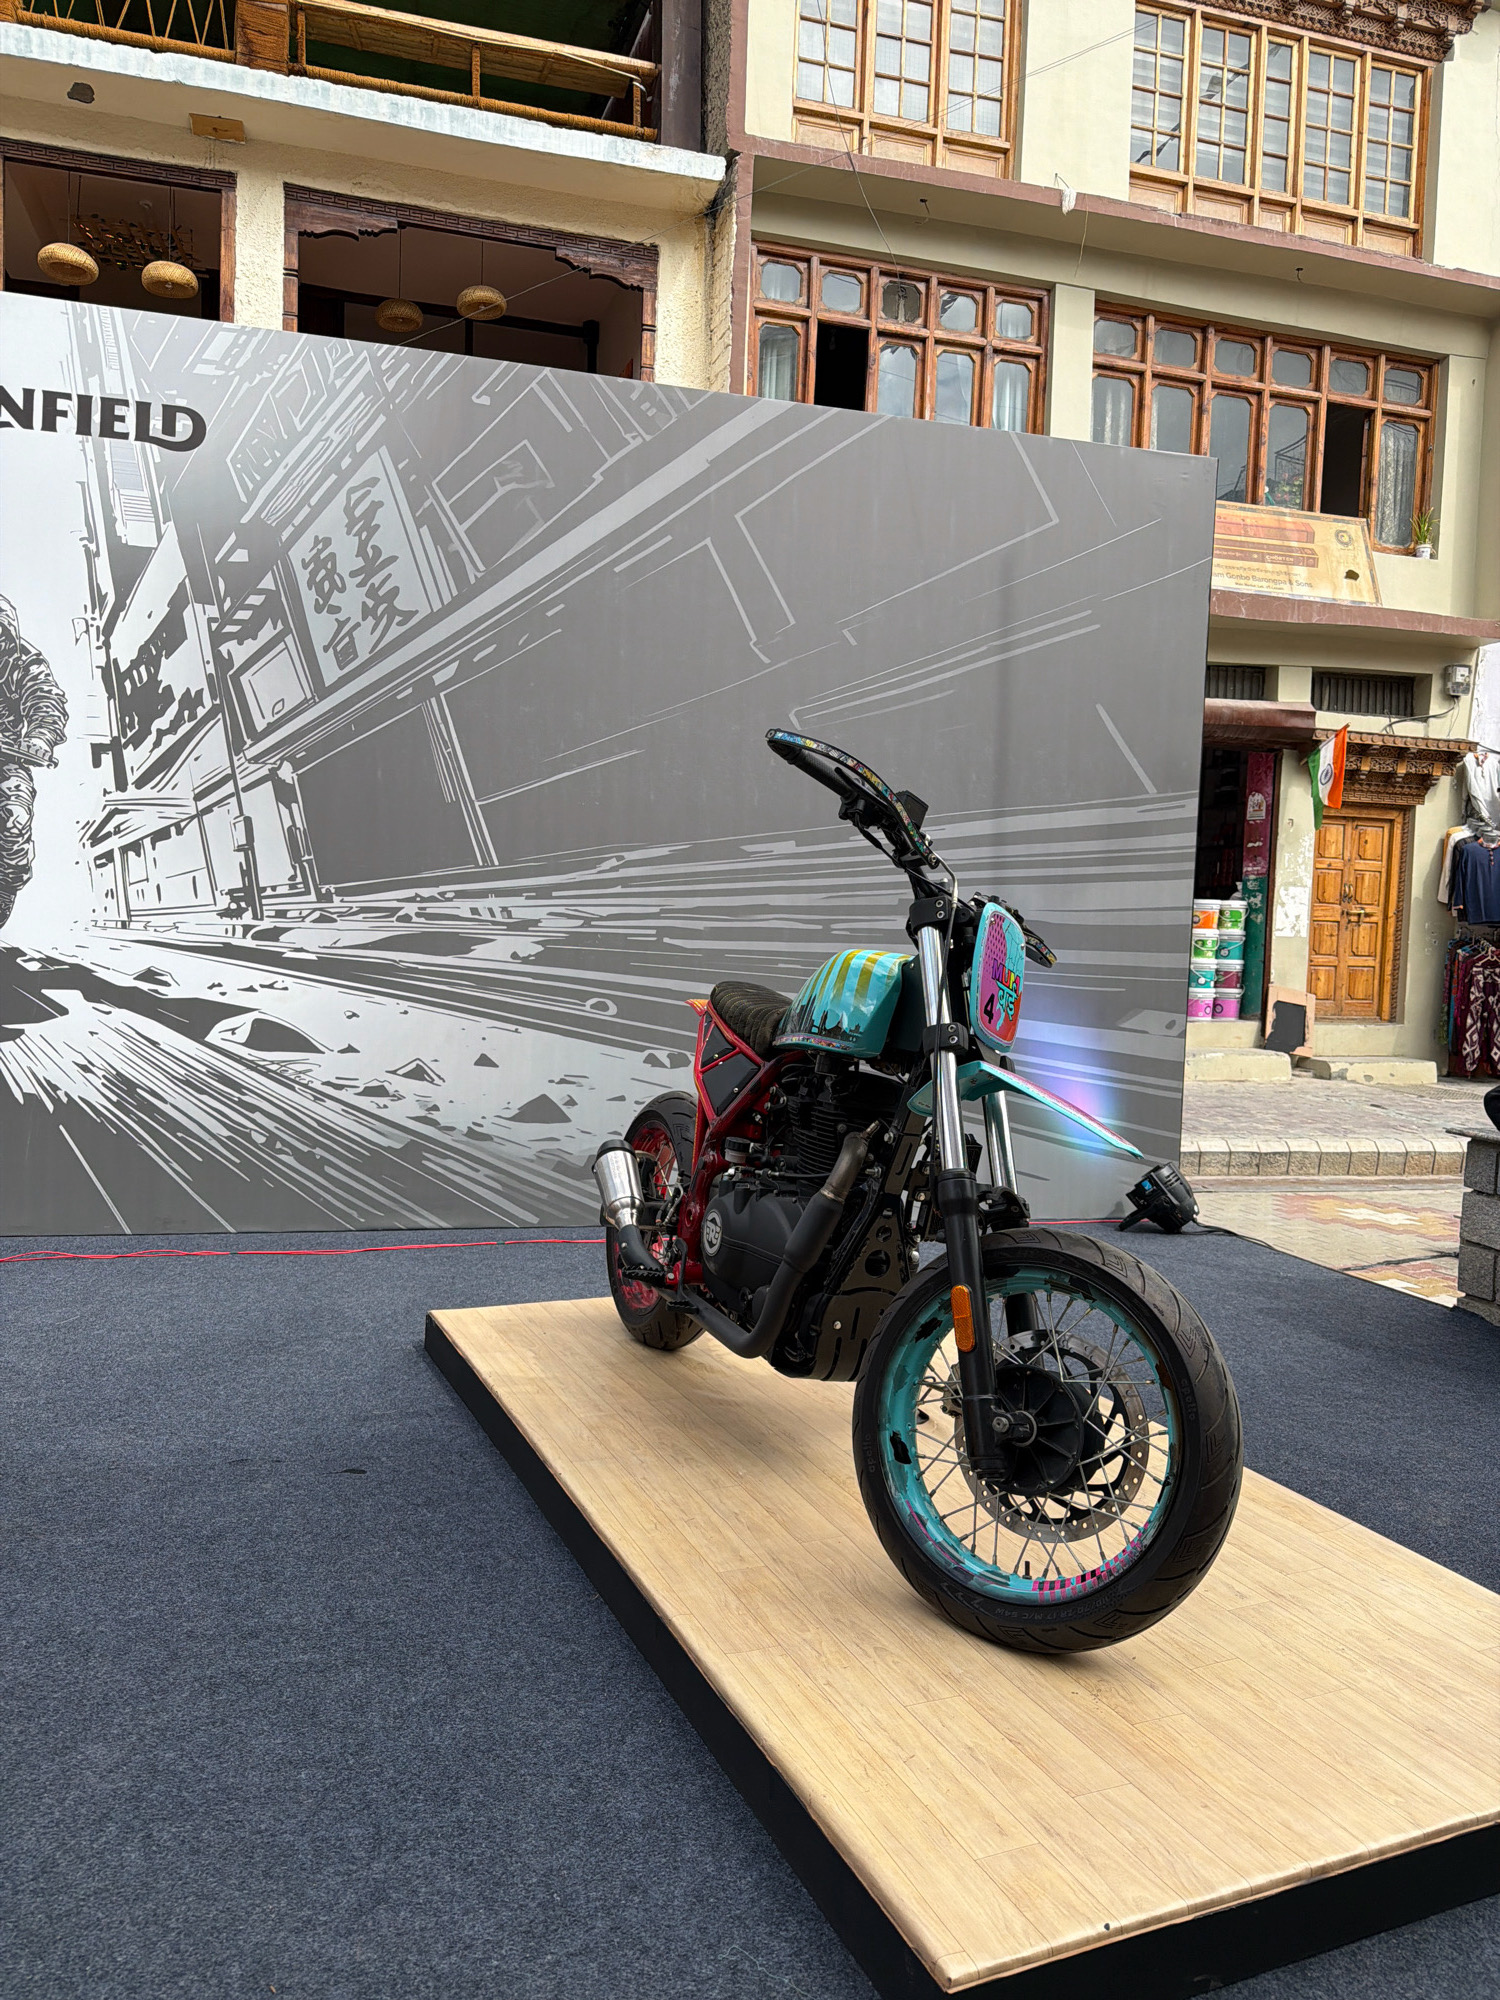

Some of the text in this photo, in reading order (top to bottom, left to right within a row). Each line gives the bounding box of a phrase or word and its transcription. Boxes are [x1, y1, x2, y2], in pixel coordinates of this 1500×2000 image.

[0, 385, 207, 453] NFIELD
[1226, 572, 1251, 581] Gonbo
[1252, 574, 1287, 586] Barongpa
[1295, 580, 1313, 588] Sons
[983, 992, 995, 1024] 4
[1180, 1378, 1197, 1421] apollo
[863, 1433, 877, 1473] apollo
[995, 1607, 1018, 1618] 54W
[1022, 1612, 1044, 1621] M/C
